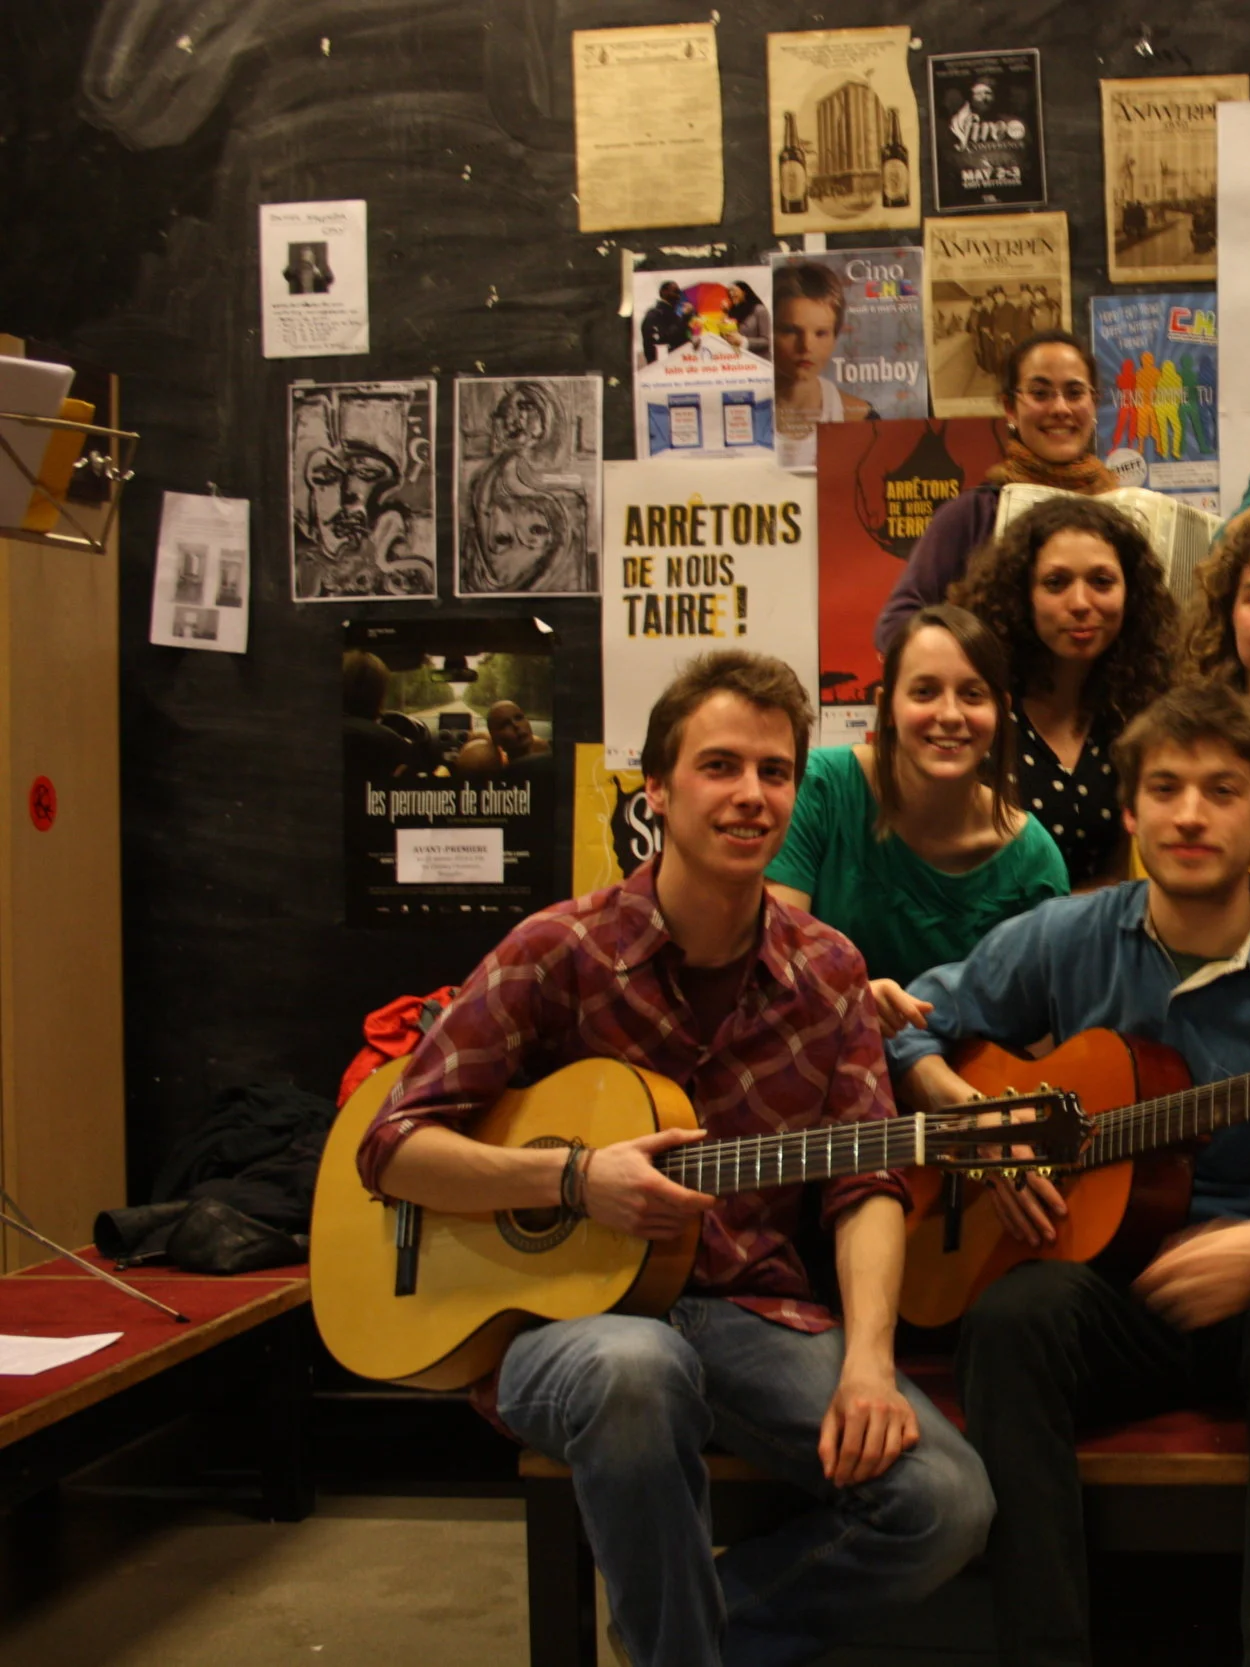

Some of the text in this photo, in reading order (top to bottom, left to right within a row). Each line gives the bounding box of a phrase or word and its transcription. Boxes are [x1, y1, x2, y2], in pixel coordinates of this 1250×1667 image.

[832, 356, 920, 386] Tomboy
[1195, 385, 1213, 405] TU
[886, 476, 960, 500] ARRÊTONS
[624, 491, 802, 547] ARRÊTONS
[888, 500, 934, 516] DE NOUS
[623, 553, 735, 589] DE NOUS
[366, 779, 532, 825] les perruques de christel
